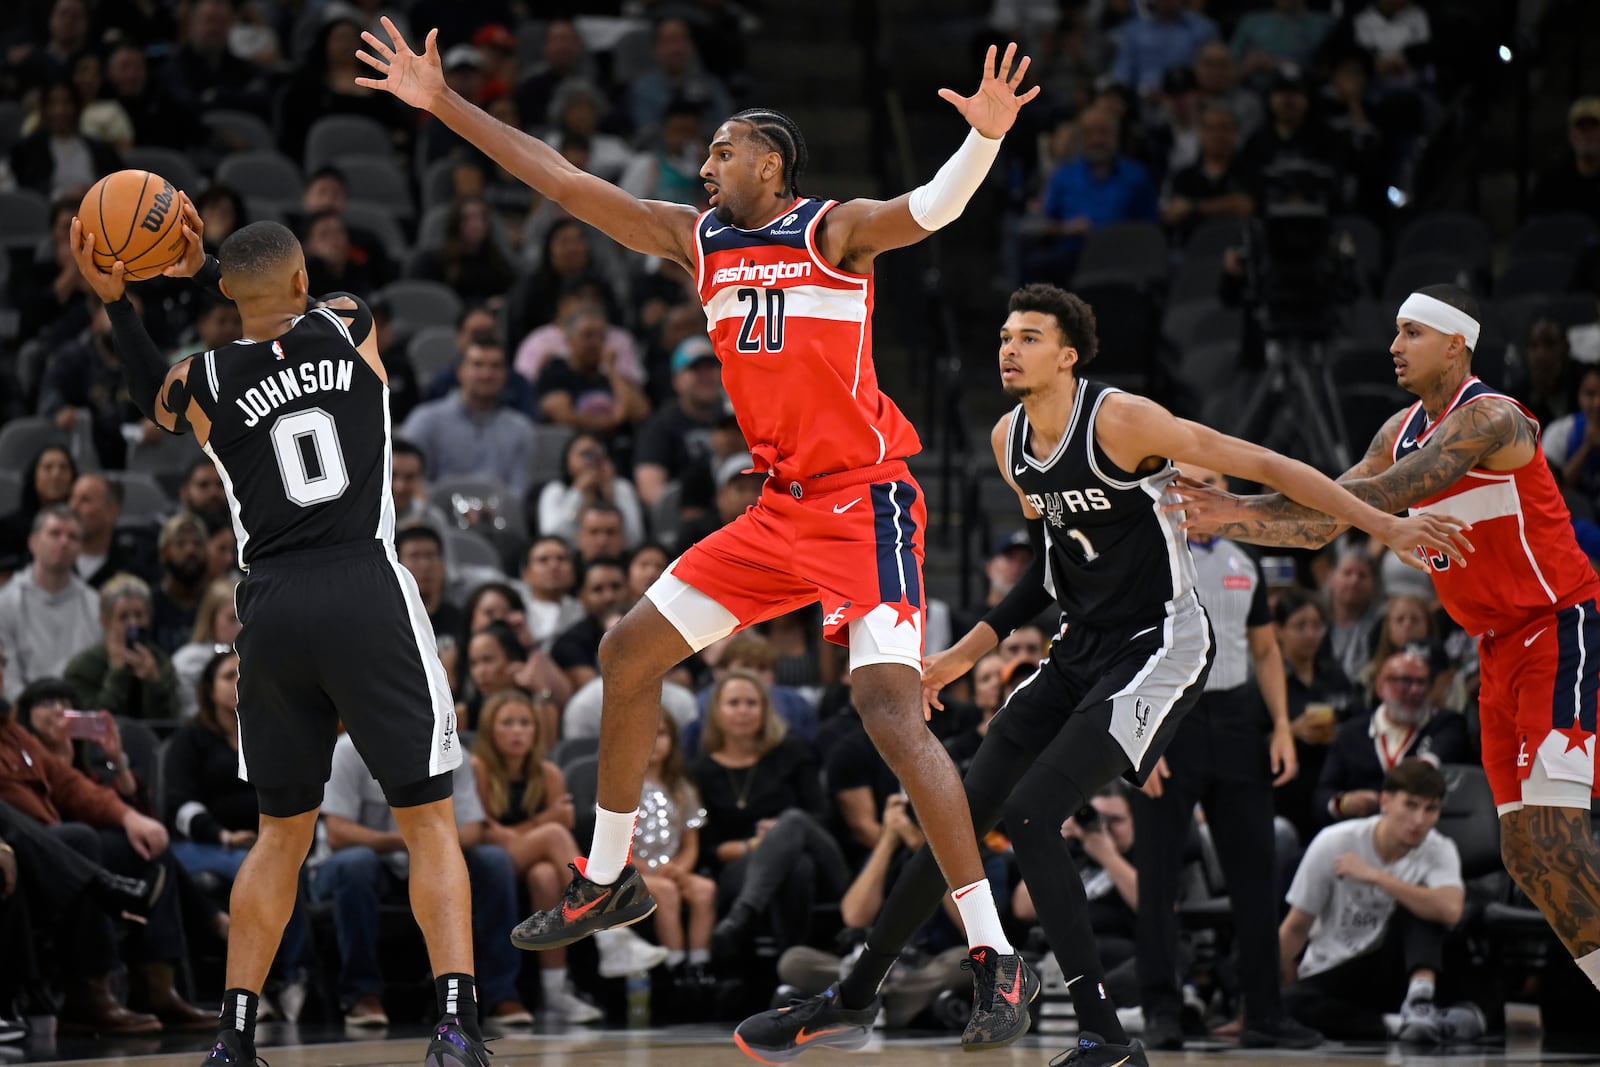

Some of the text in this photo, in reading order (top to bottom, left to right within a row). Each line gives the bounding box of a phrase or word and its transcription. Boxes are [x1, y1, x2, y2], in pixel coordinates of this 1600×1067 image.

[736, 288, 785, 353] 20
[235, 359, 354, 428] JOHNSON
[269, 406, 350, 508] 0
[1066, 529, 1100, 562] 1
